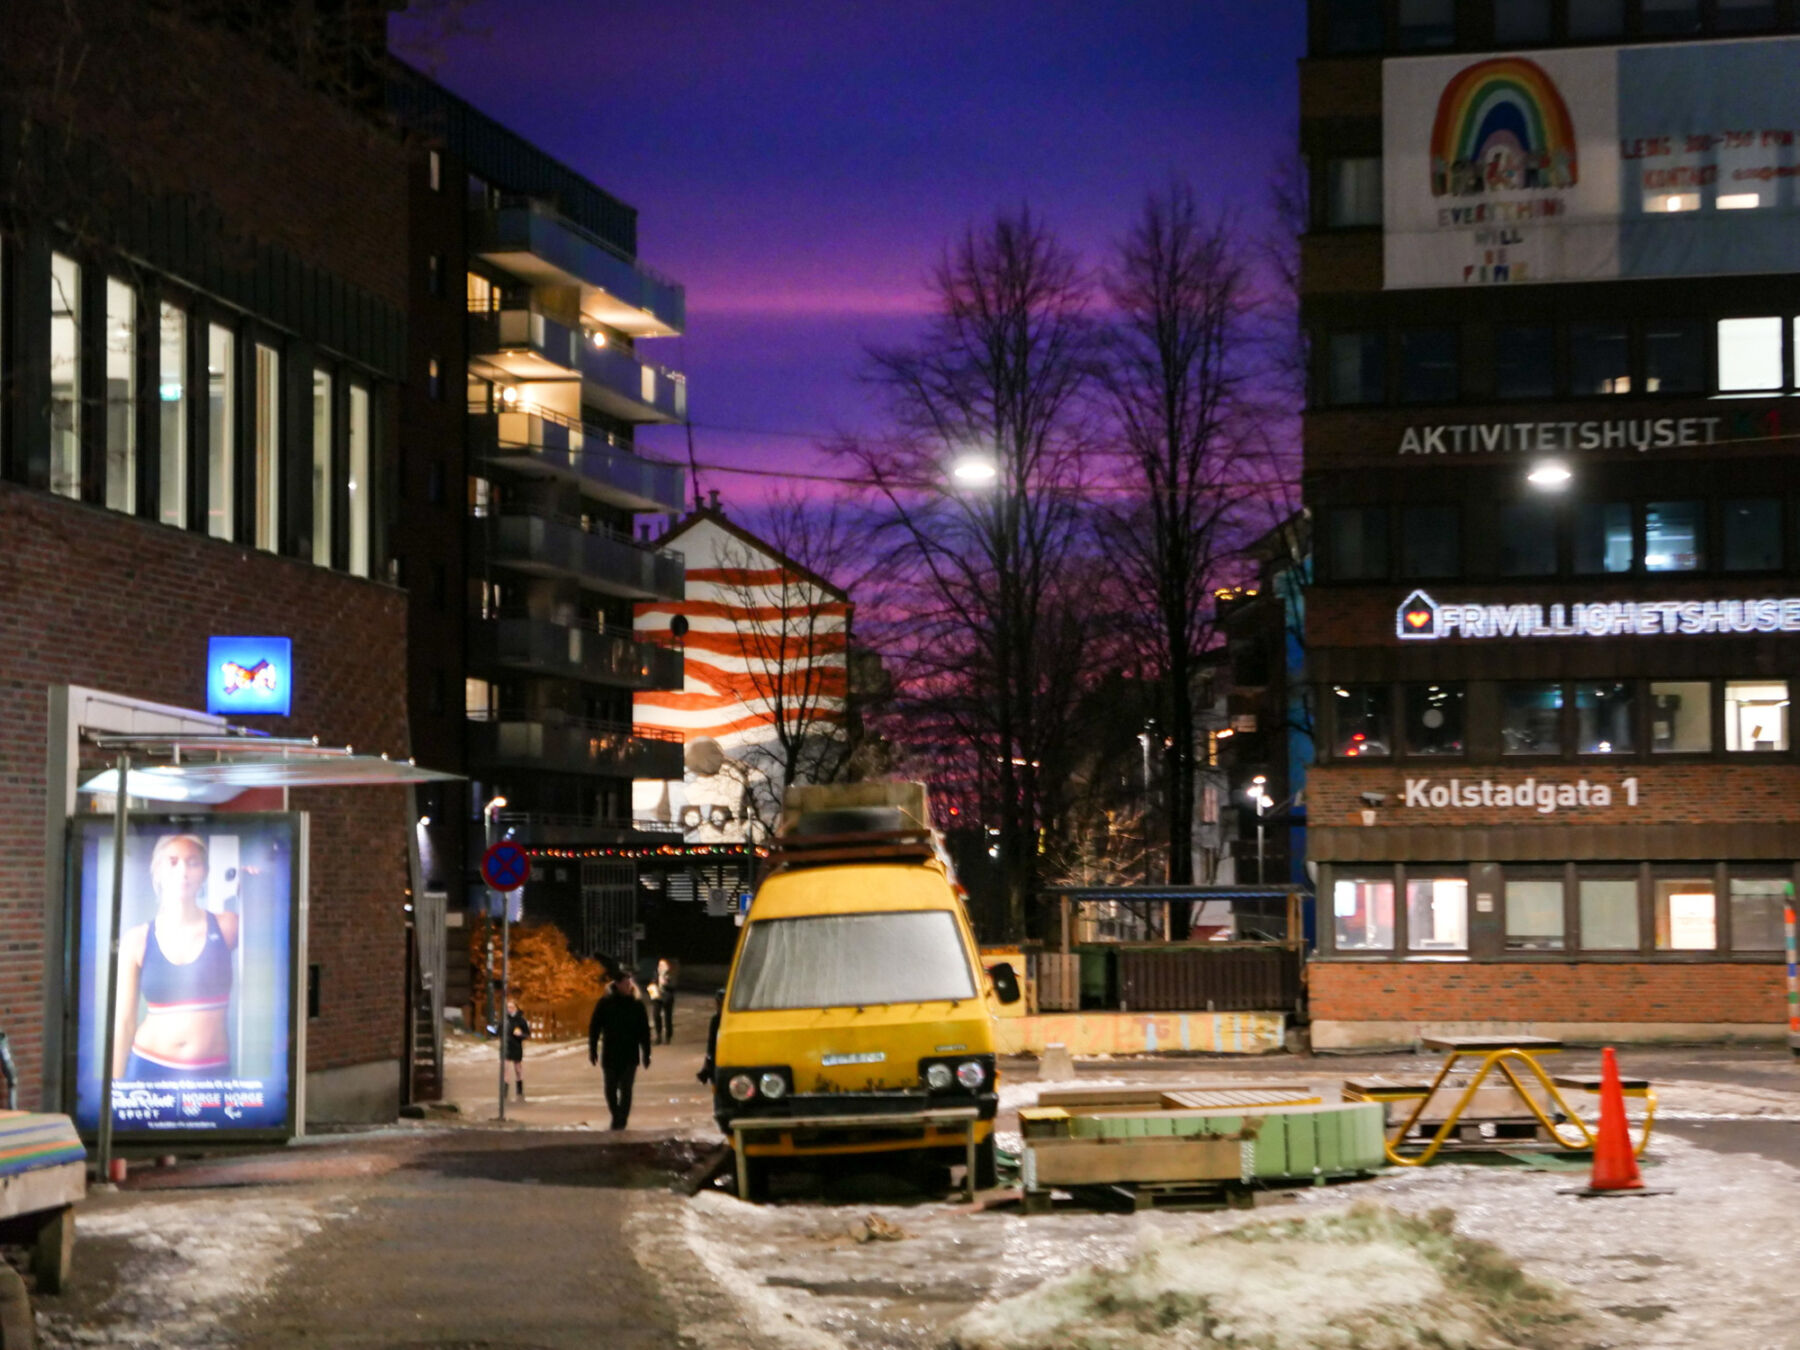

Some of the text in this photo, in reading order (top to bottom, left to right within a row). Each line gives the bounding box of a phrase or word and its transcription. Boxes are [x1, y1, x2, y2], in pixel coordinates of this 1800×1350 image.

[1438, 198, 1566, 227] EVERYTHING
[1475, 228, 1524, 246] WILL
[1463, 262, 1528, 283] FINE
[1399, 416, 1721, 455] AKTIVITETSHUSET
[1404, 777, 1640, 814] Kolstadgata 1
